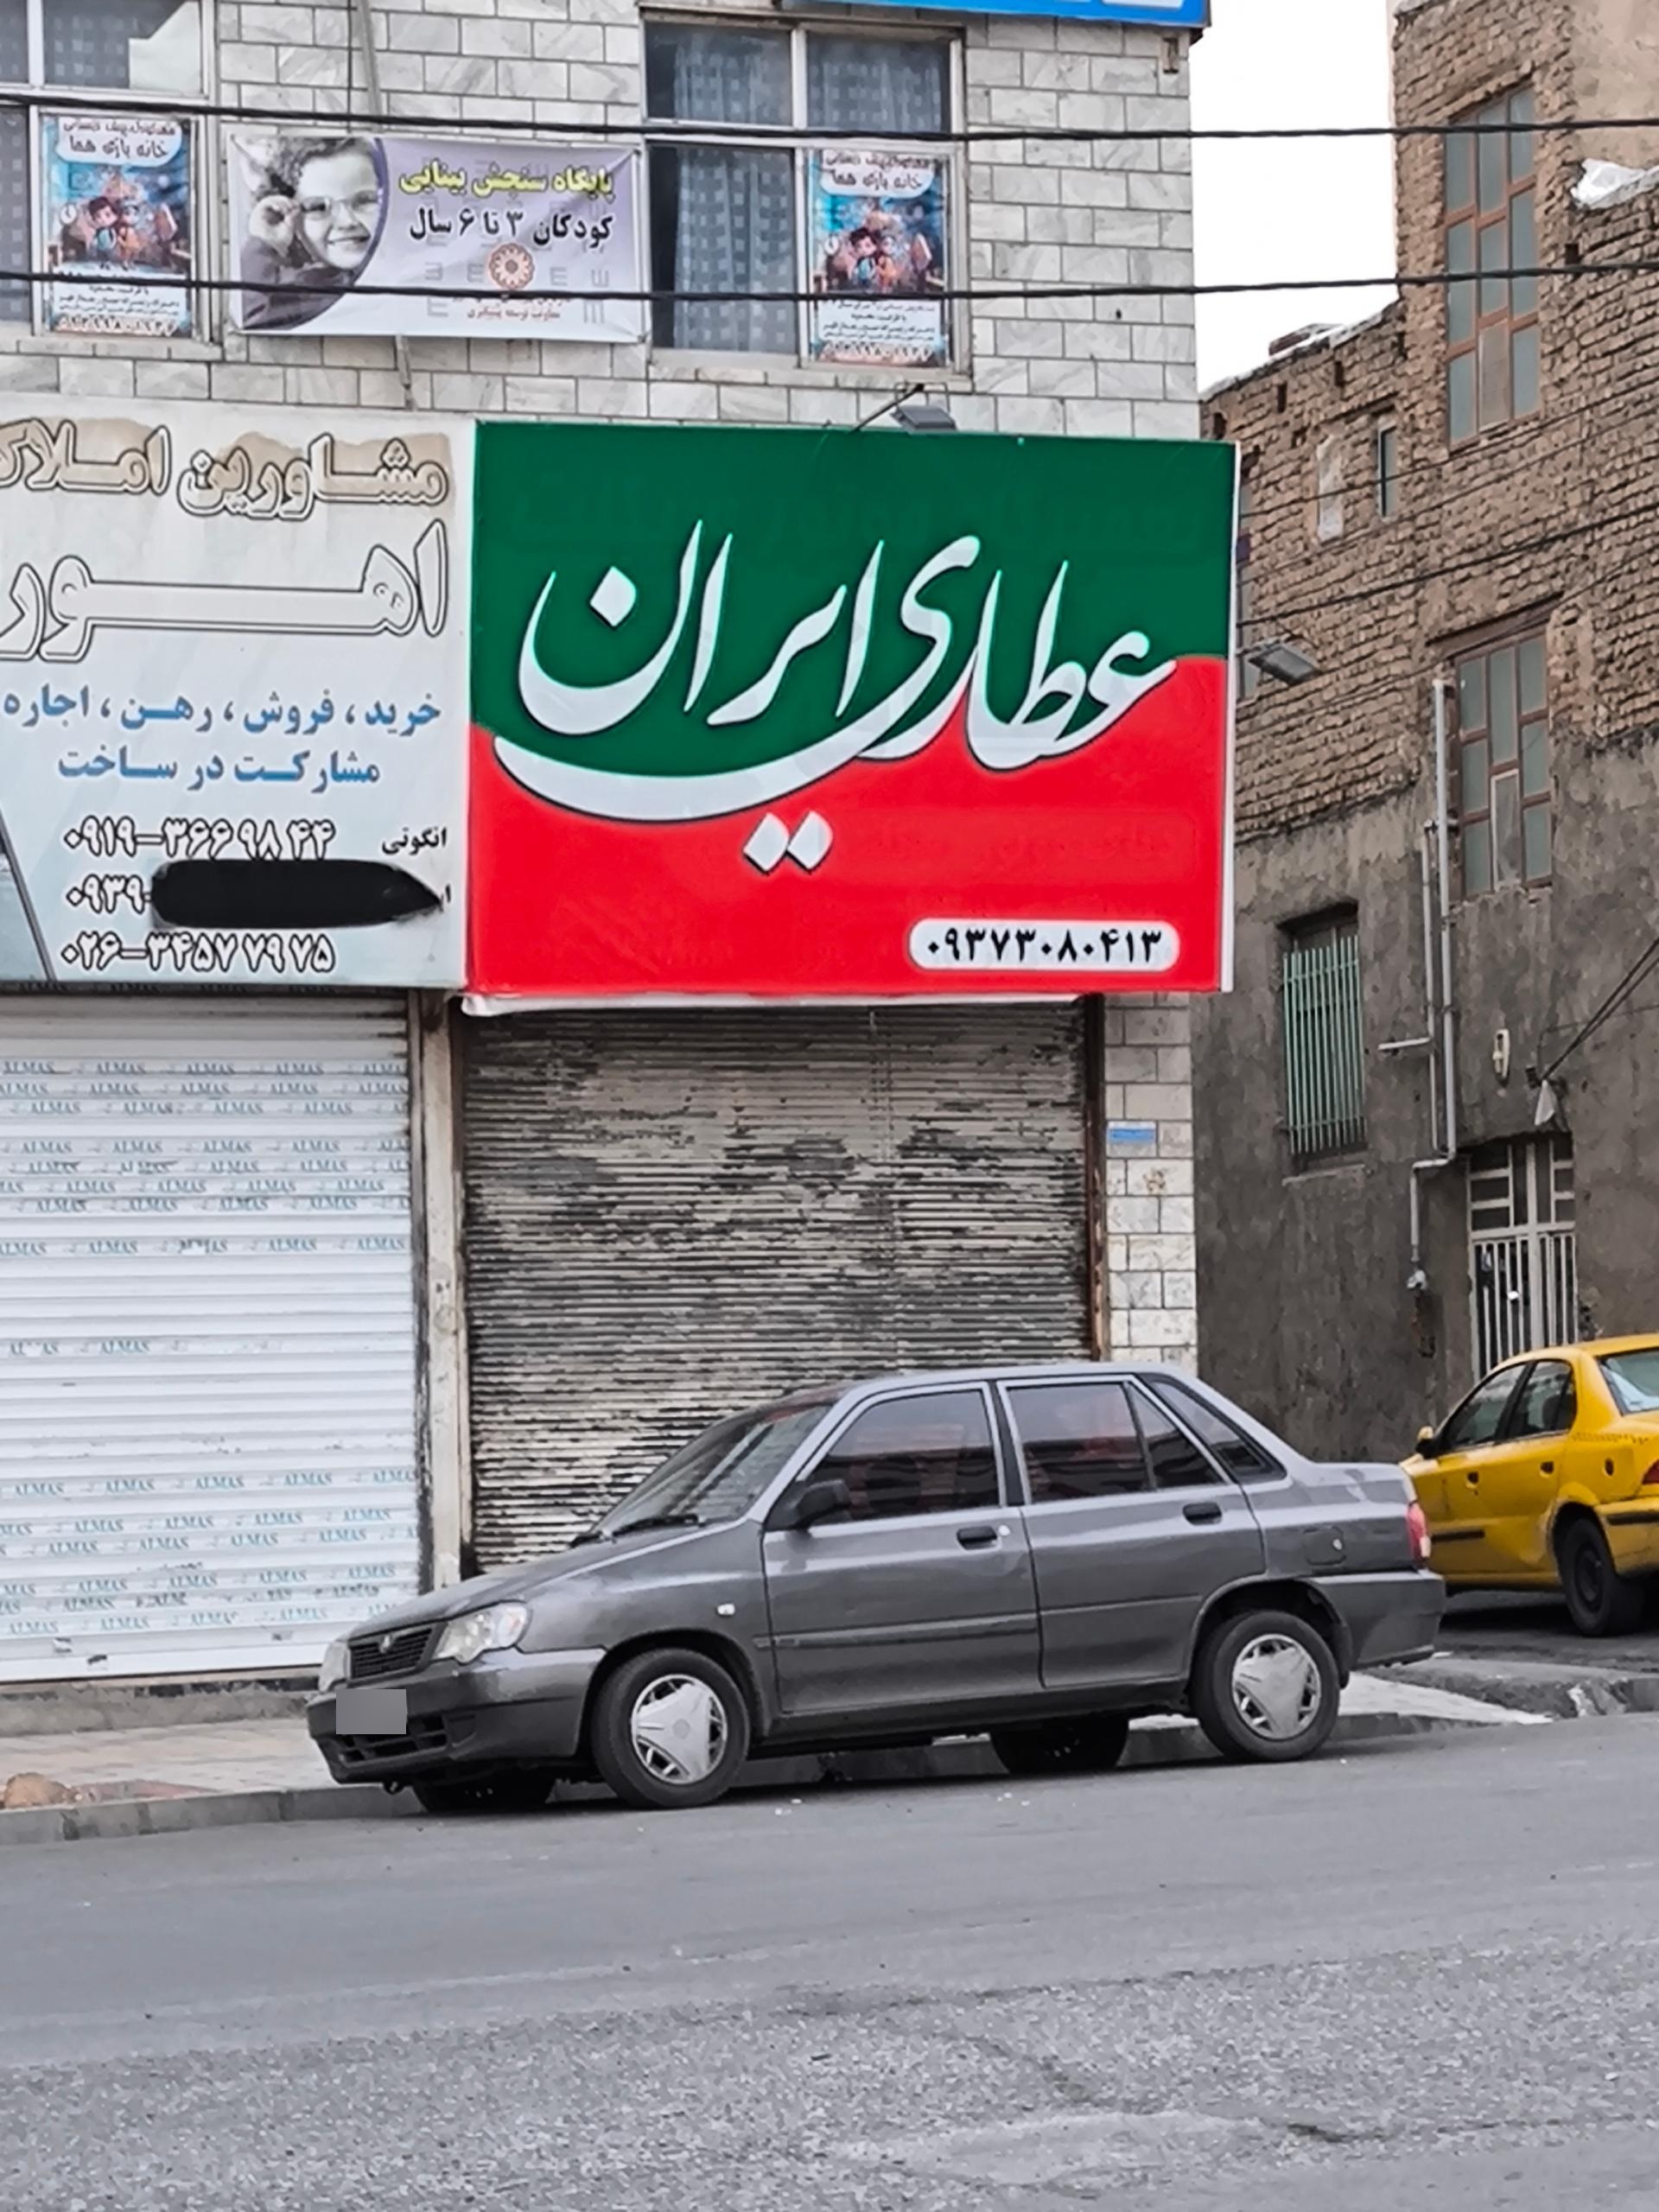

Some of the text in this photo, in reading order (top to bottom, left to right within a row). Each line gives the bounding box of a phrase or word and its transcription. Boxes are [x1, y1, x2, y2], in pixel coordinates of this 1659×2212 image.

[398, 158, 615, 204] پایگاه سنجش بینایی
[410, 207, 613, 249] کودکان ۳ تا ۶ سال
[176, 431, 450, 521] مشاورین
[3, 683, 89, 727] اجاره
[58, 745, 380, 794] مشارکت در ساخت
[928, 927, 1161, 963] ۰۹۳۷۳۰۸۰۴۱۳
